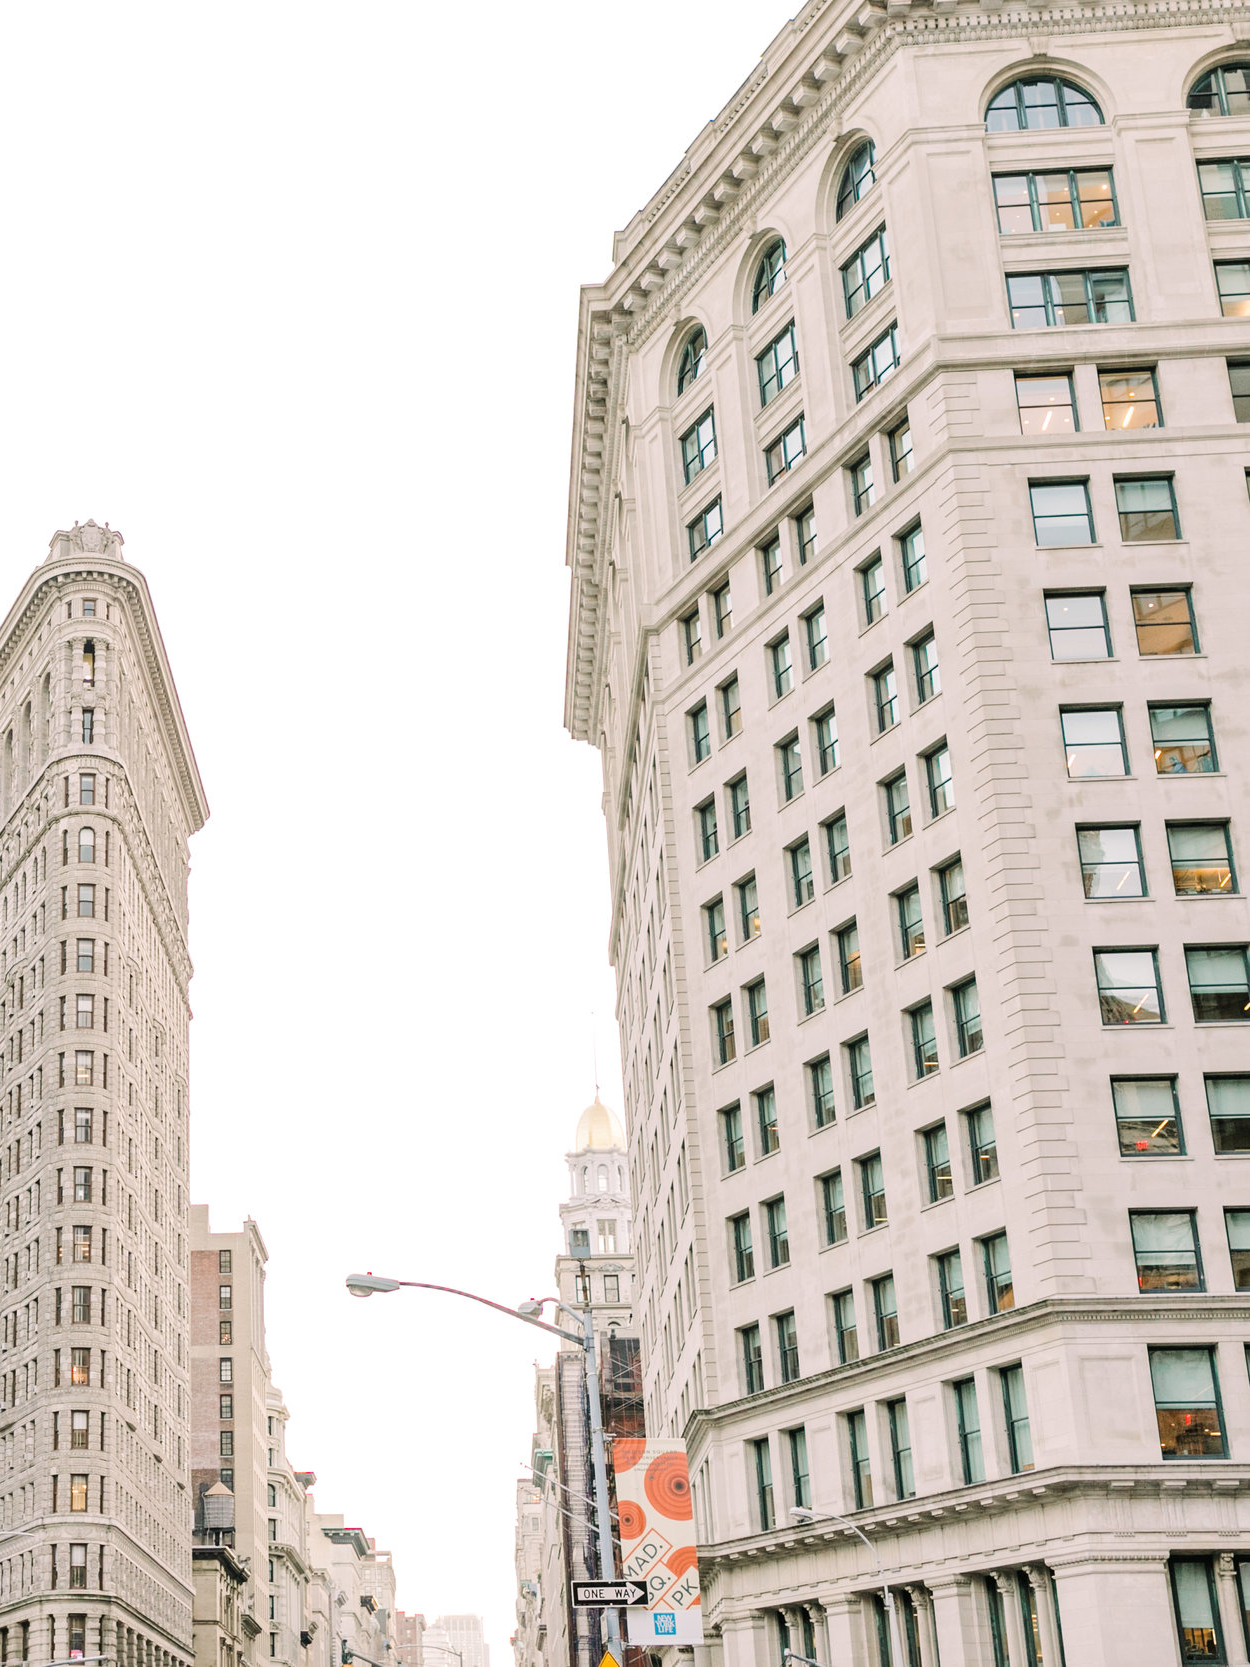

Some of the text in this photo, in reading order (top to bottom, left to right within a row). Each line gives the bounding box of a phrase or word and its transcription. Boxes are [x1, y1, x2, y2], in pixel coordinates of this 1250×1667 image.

[623, 1543, 663, 1580] MAD.
[583, 1588, 637, 1599] ONE WAY
[671, 1578, 698, 1606] PK
[654, 1620, 675, 1628] YORK
